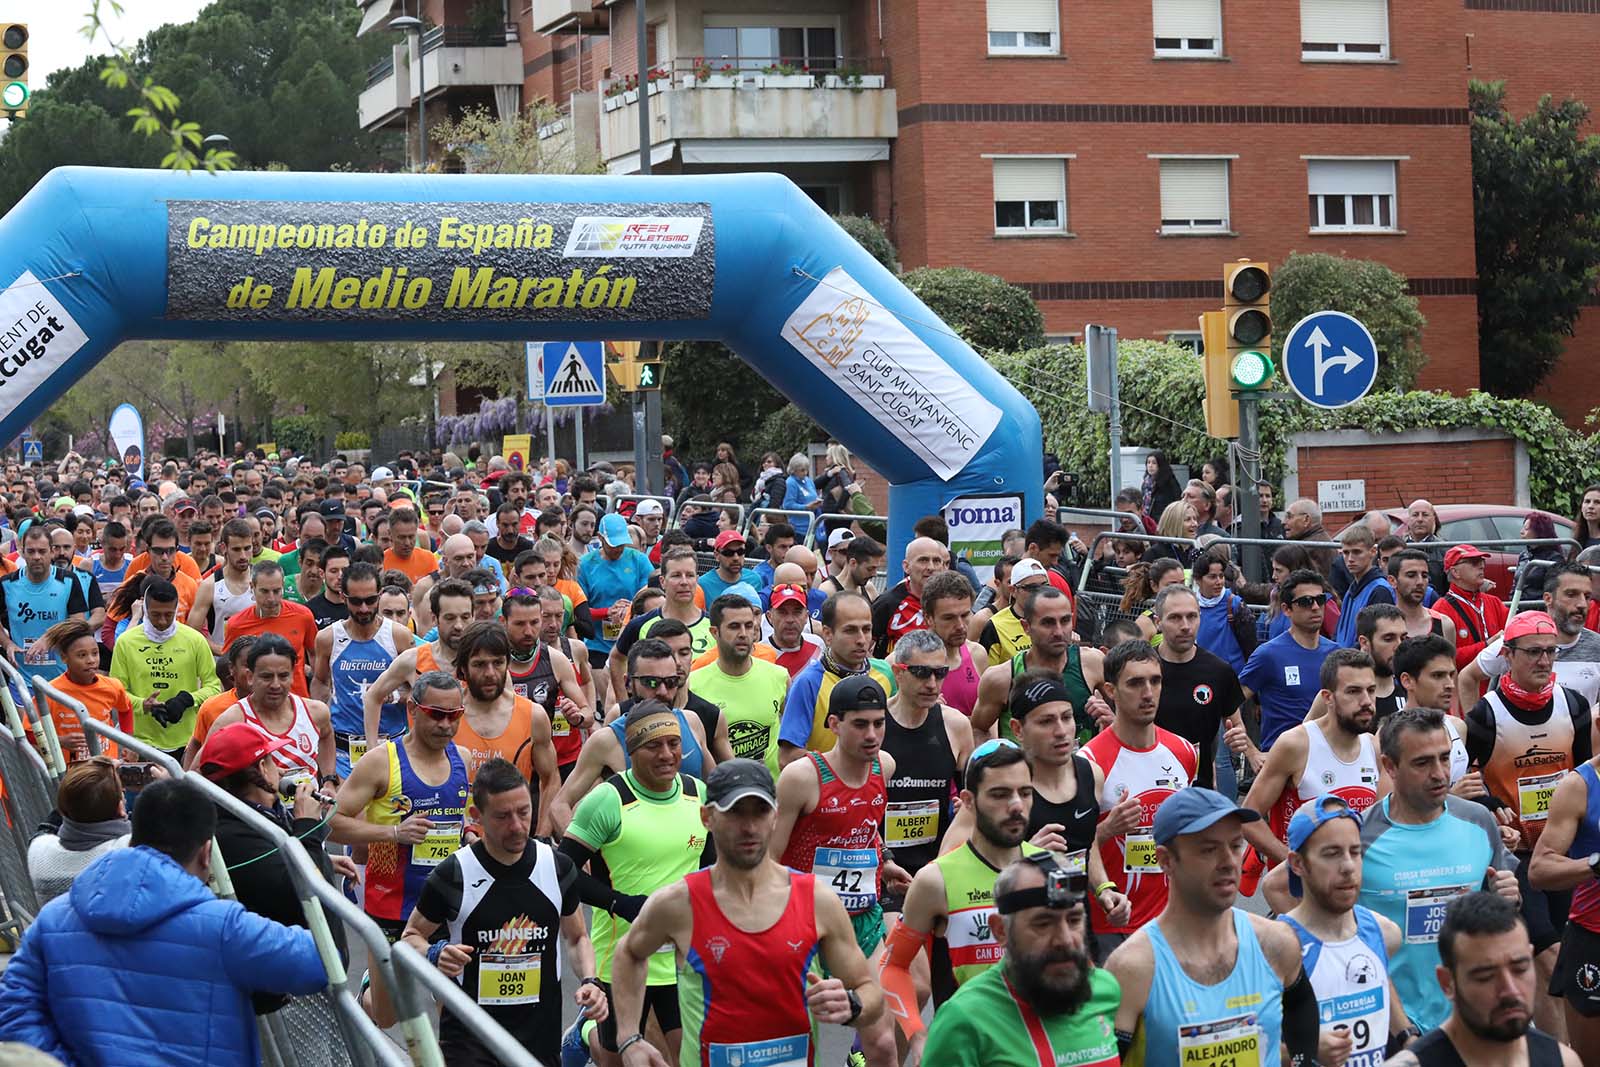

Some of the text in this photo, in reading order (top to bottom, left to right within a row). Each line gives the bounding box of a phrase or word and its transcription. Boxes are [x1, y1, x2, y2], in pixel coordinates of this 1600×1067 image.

[187, 217, 554, 256] Campeonato de España
[622, 234, 689, 242] ATLETISMO
[649, 243, 693, 251] RUNNING
[225, 264, 637, 309] de Medio Maratón
[26, 300, 50, 324] DE
[849, 362, 925, 430] SANT CUGAT
[862, 349, 975, 451] CLUB MUNTANYENC
[1320, 500, 1364, 510] SANTA TERESA
[37, 611, 59, 621] TEAM
[145, 657, 174, 667] CURSA
[1536, 789, 1555, 800] TON
[896, 816, 931, 827] ALBERT
[903, 827, 924, 838] 166
[431, 847, 449, 858] 745
[1131, 844, 1150, 852] JUAN
[832, 869, 862, 892] 42
[477, 926, 549, 943] RUNNERS
[976, 948, 992, 960] CAN
[497, 972, 526, 982] JOAN
[499, 983, 524, 996] 893
[1186, 1037, 1257, 1062] ALEJANDRO
